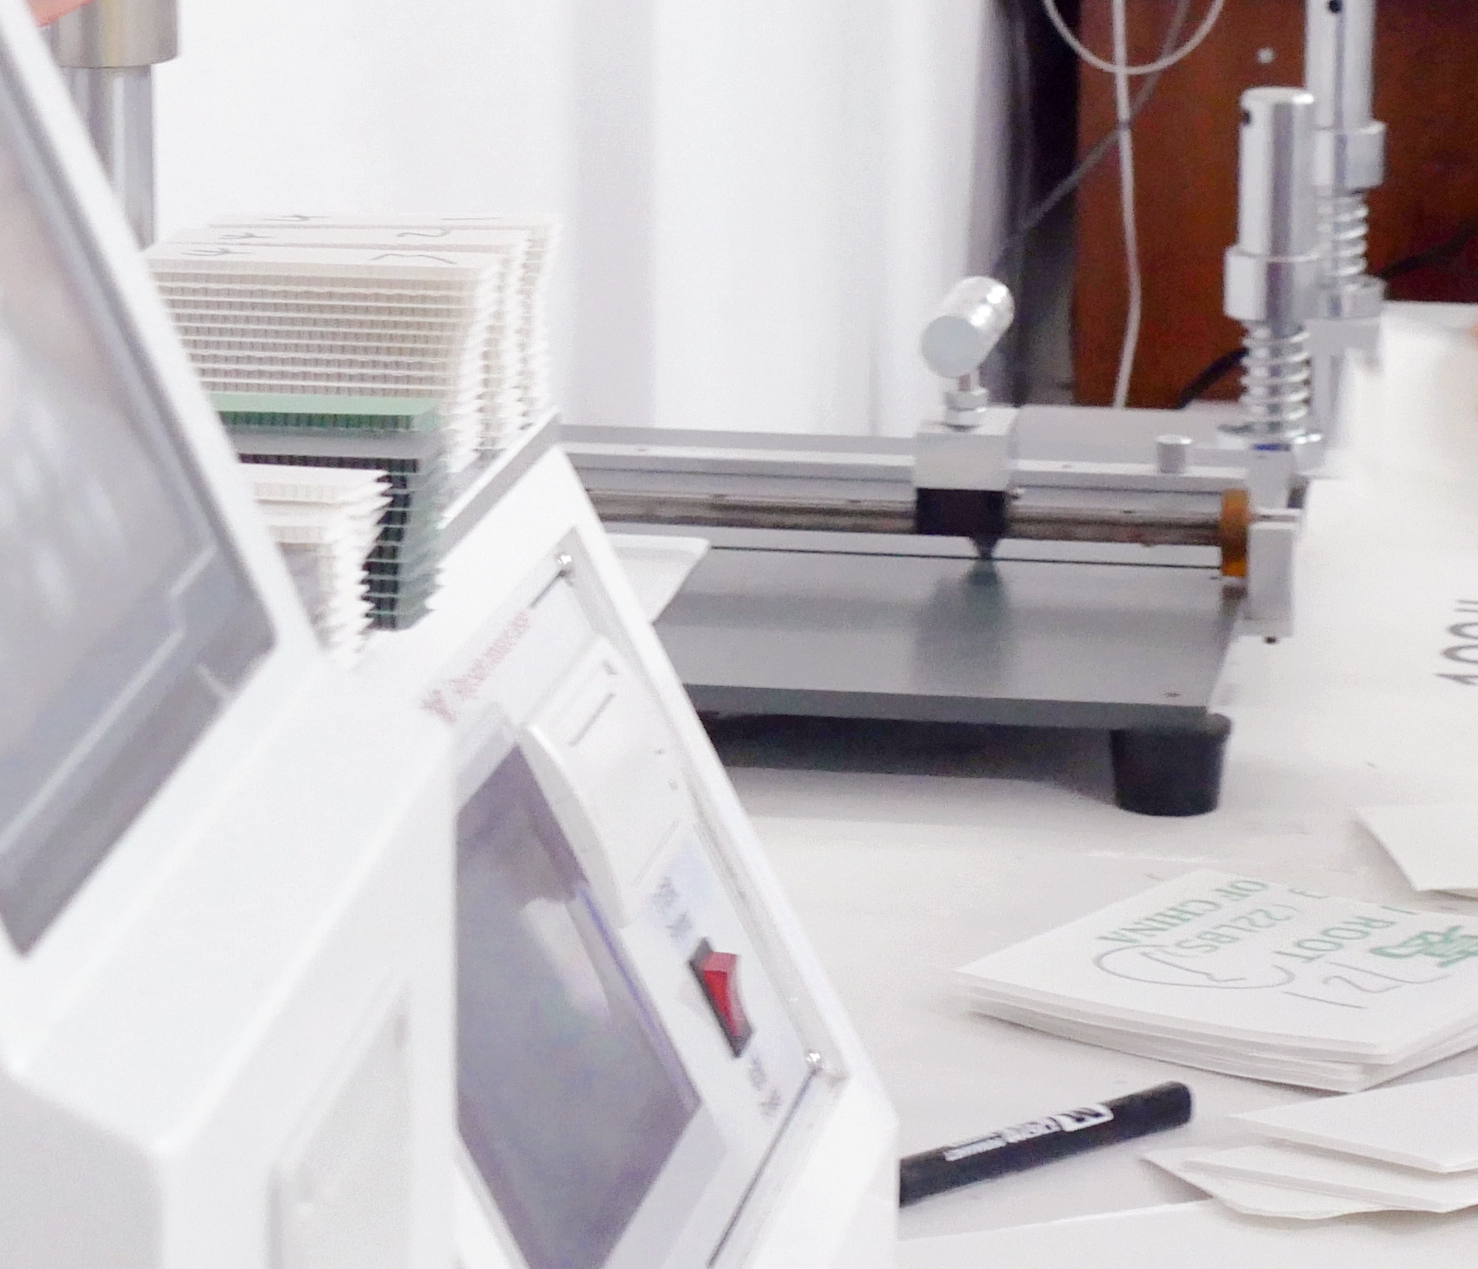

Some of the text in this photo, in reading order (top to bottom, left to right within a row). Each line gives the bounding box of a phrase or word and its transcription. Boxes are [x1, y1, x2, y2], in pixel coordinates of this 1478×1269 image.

[1096, 879, 1269, 947] OF CHINA
[1275, 913, 1399, 962] ROOT
